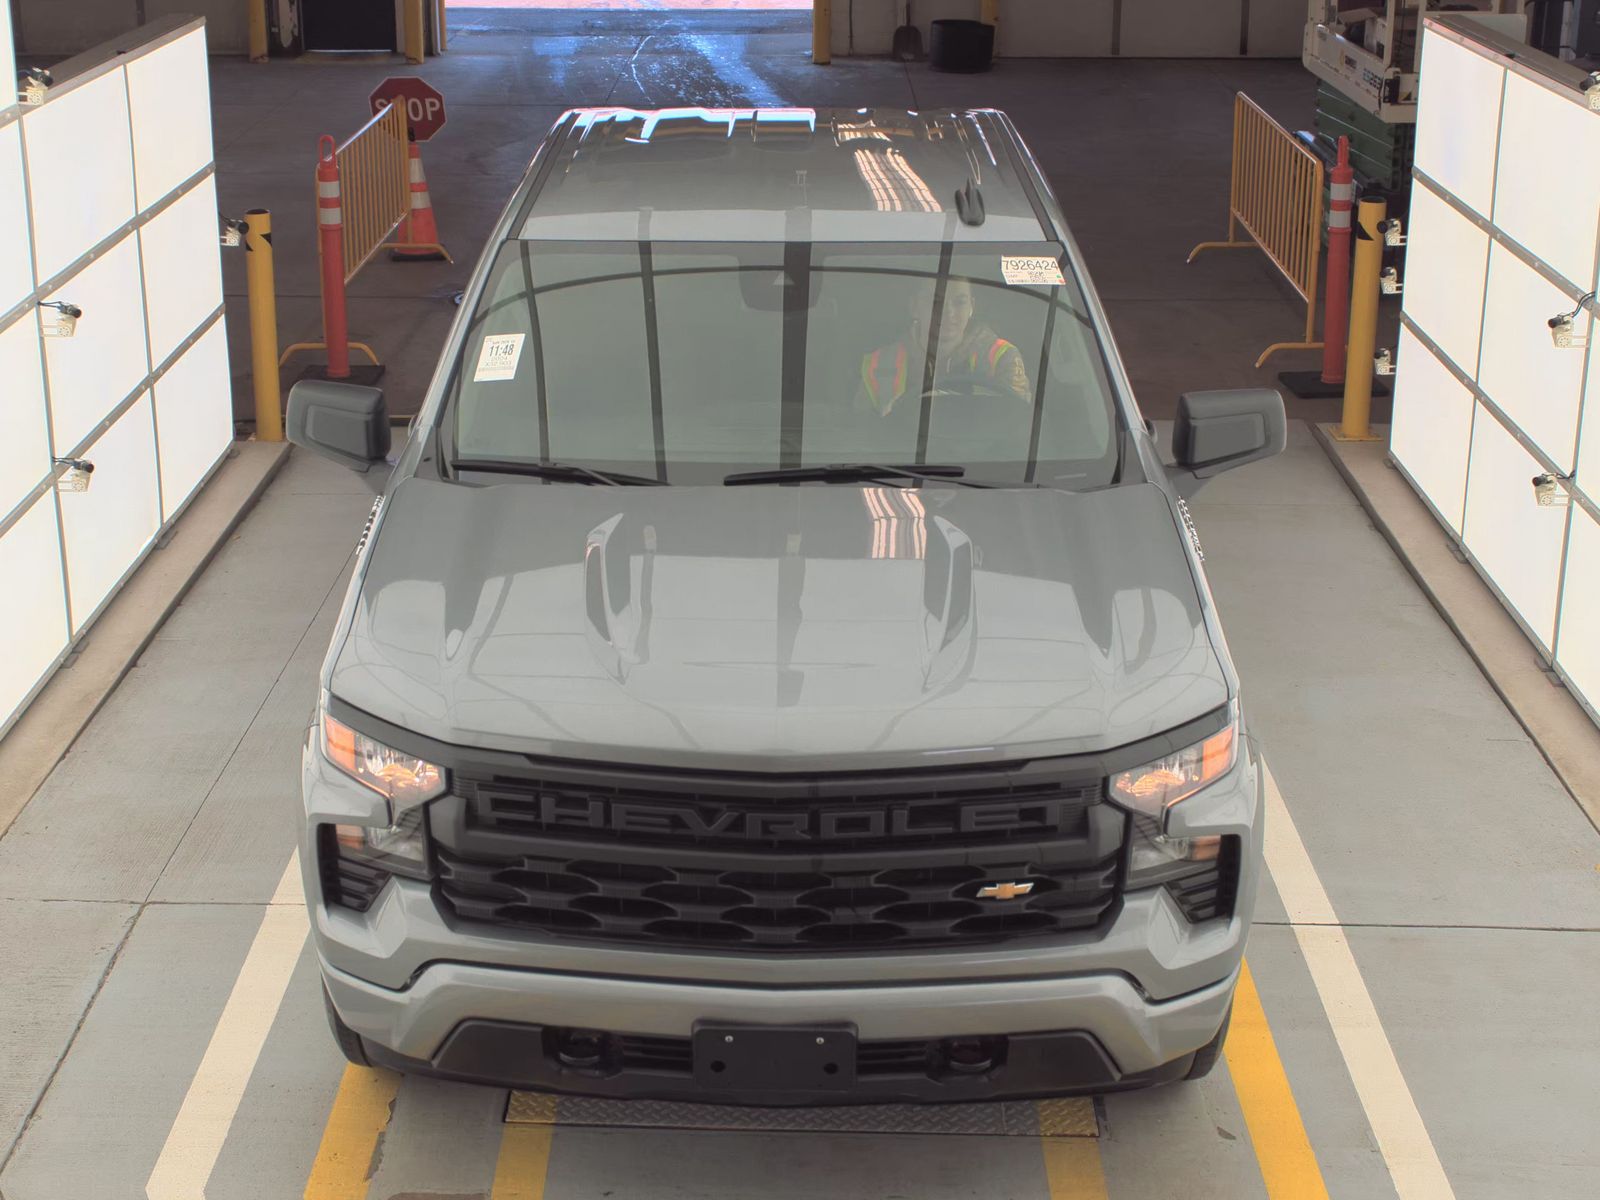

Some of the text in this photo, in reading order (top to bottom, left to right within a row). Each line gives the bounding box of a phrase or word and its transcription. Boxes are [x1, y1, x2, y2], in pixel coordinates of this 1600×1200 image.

[374, 98, 440, 121] SOP
[1002, 260, 1058, 271] 7926424
[489, 344, 515, 357] 11:48
[476, 788, 1068, 840] CHEVROLET
